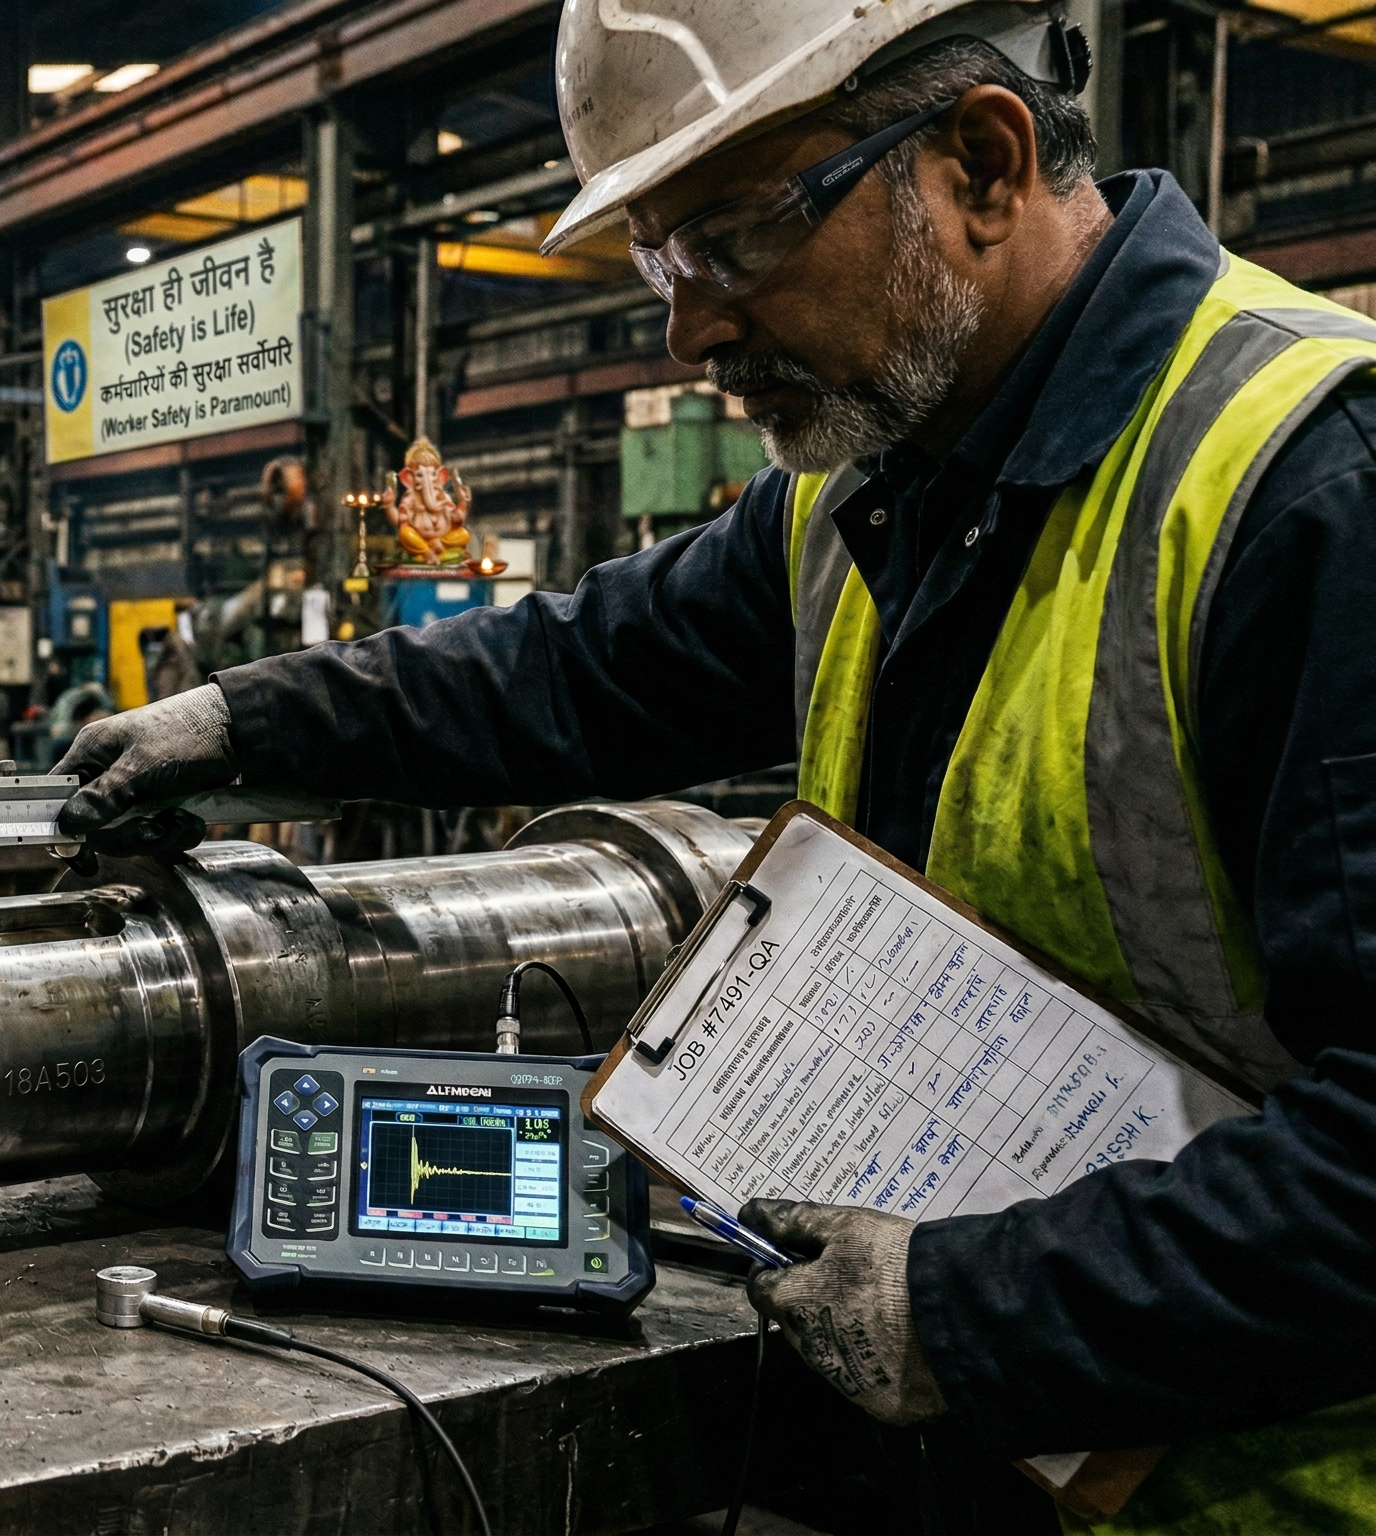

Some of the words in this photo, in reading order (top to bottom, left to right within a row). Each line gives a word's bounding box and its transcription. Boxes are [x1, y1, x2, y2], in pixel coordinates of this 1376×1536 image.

[102, 285, 155, 335] सुरक्षा
[160, 267, 183, 311] ही
[190, 256, 252, 298] जीवन
[256, 237, 276, 283] है
[124, 322, 186, 365] (Safety
[191, 316, 207, 342] is
[213, 299, 256, 336] Life)
[100, 365, 165, 404] कर्मचारियों
[169, 360, 188, 388] की
[192, 357, 232, 392] सुरक्षा
[236, 336, 293, 374] सर्वोपरि
[101, 412, 148, 443] (Worker
[151, 402, 191, 429] Safety
[195, 398, 206, 420] is
[210, 381, 292, 417] Paramount)
[673, 1040, 706, 1081] JOB
[701, 940, 780, 1039] #7491-QA
[4, 1058, 106, 1096] 18A503
